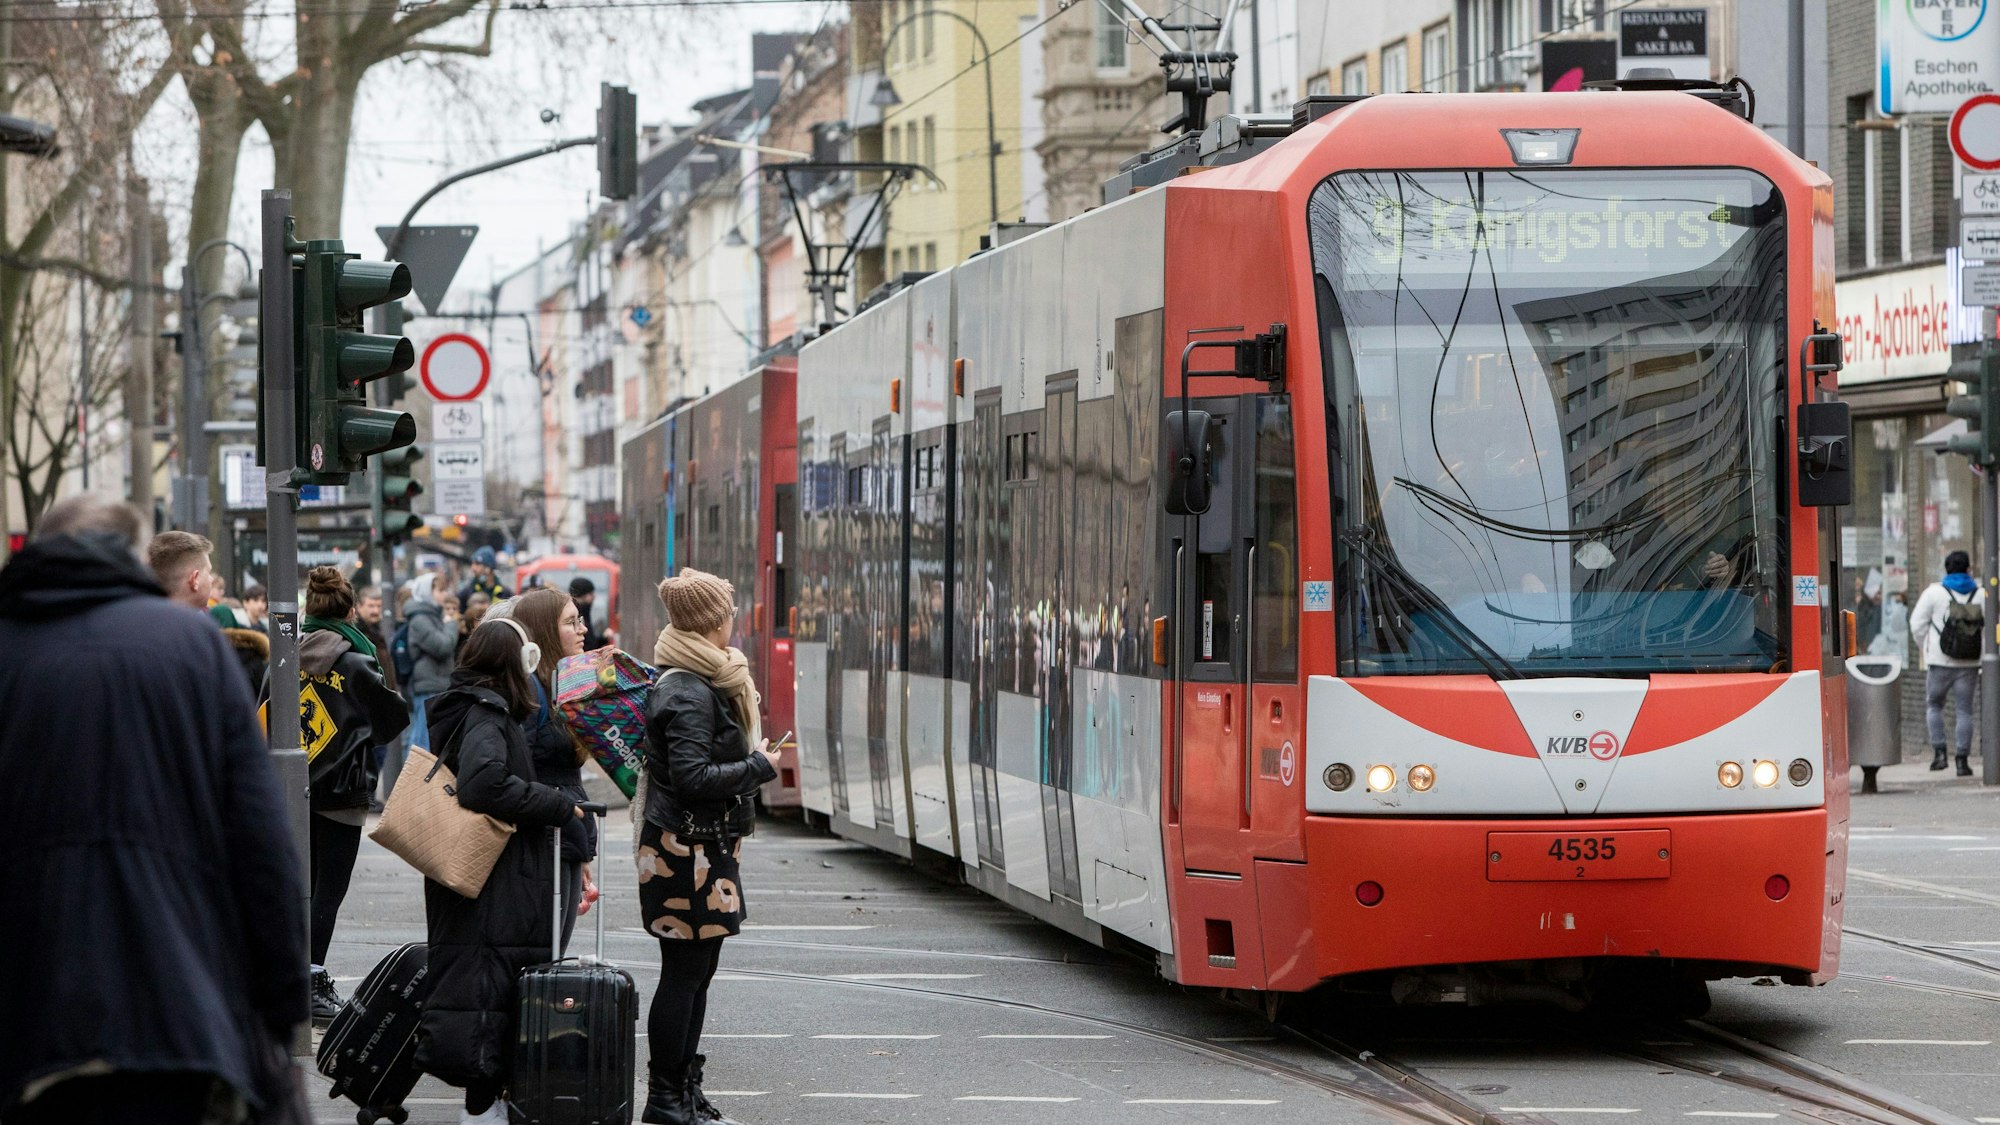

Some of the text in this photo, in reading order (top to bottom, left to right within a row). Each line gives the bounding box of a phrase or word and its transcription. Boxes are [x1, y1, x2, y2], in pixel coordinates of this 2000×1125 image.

[1635, 40, 1696, 54] SAKE BAR
[1914, 59, 1979, 75] Eschen
[1905, 79, 1987, 99] Apotheke
[1981, 201, 1999, 210] frei
[1432, 194, 1732, 263] Königsforst
[1981, 246, 1999, 255] frei
[1837, 284, 1949, 375] en-Apotheke
[1547, 737, 1588, 754] KVB
[1548, 837, 1617, 861] 4535
[1576, 866, 1585, 878] 2
[356, 1011, 397, 1065] TRAVELLER
